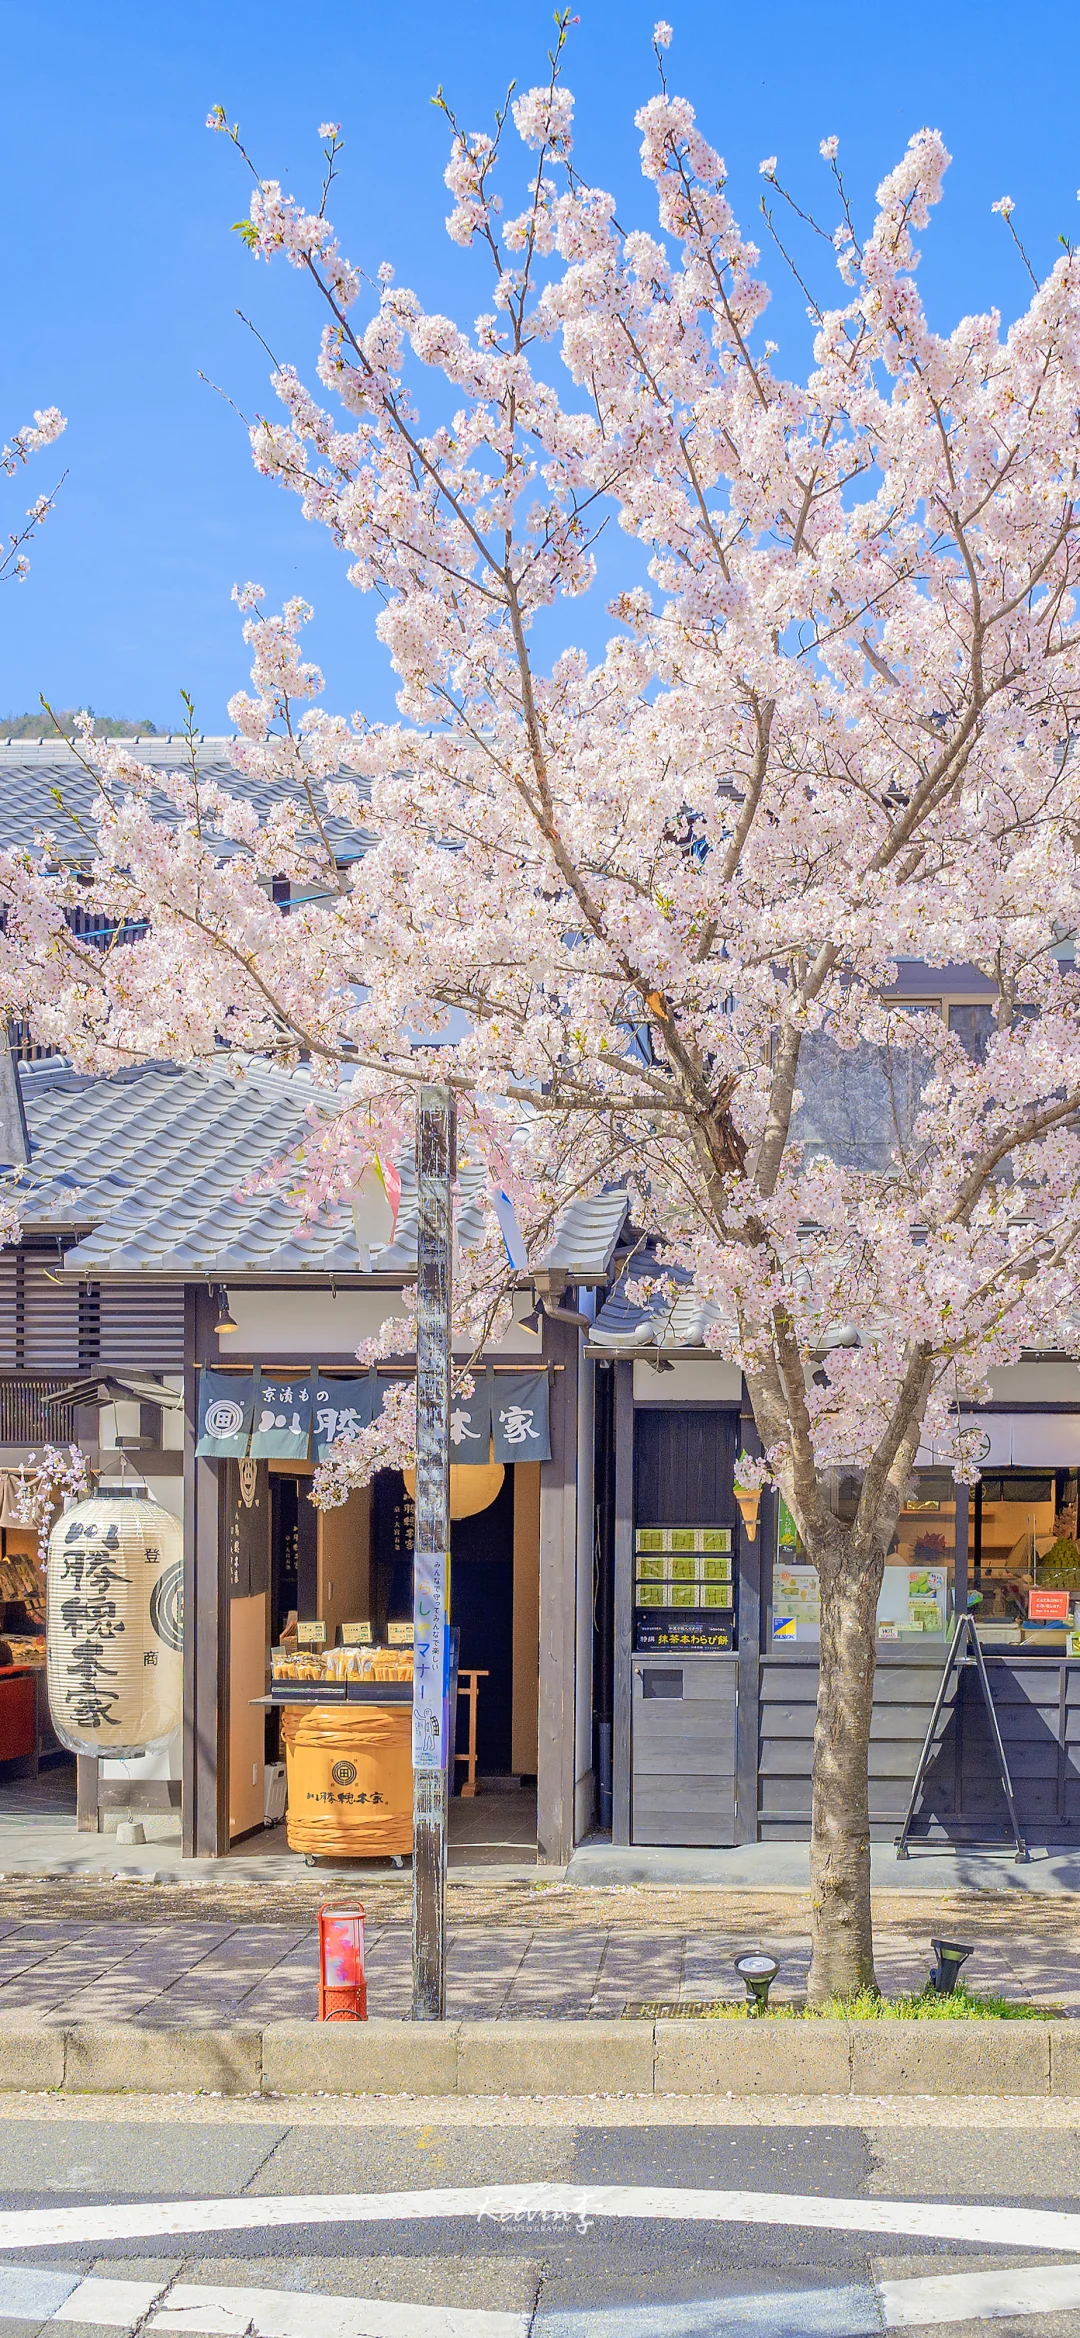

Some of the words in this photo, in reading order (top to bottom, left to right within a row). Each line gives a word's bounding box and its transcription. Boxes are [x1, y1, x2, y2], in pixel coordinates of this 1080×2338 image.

[258, 1406, 541, 1446] 川勝本家
[144, 1548, 160, 1564] 登
[431, 1561, 441, 1671] みんなで守ってみんなで楽しい
[657, 1634, 729, 1646] 抹茶本わらび餅
[143, 1650, 158, 1667] 商
